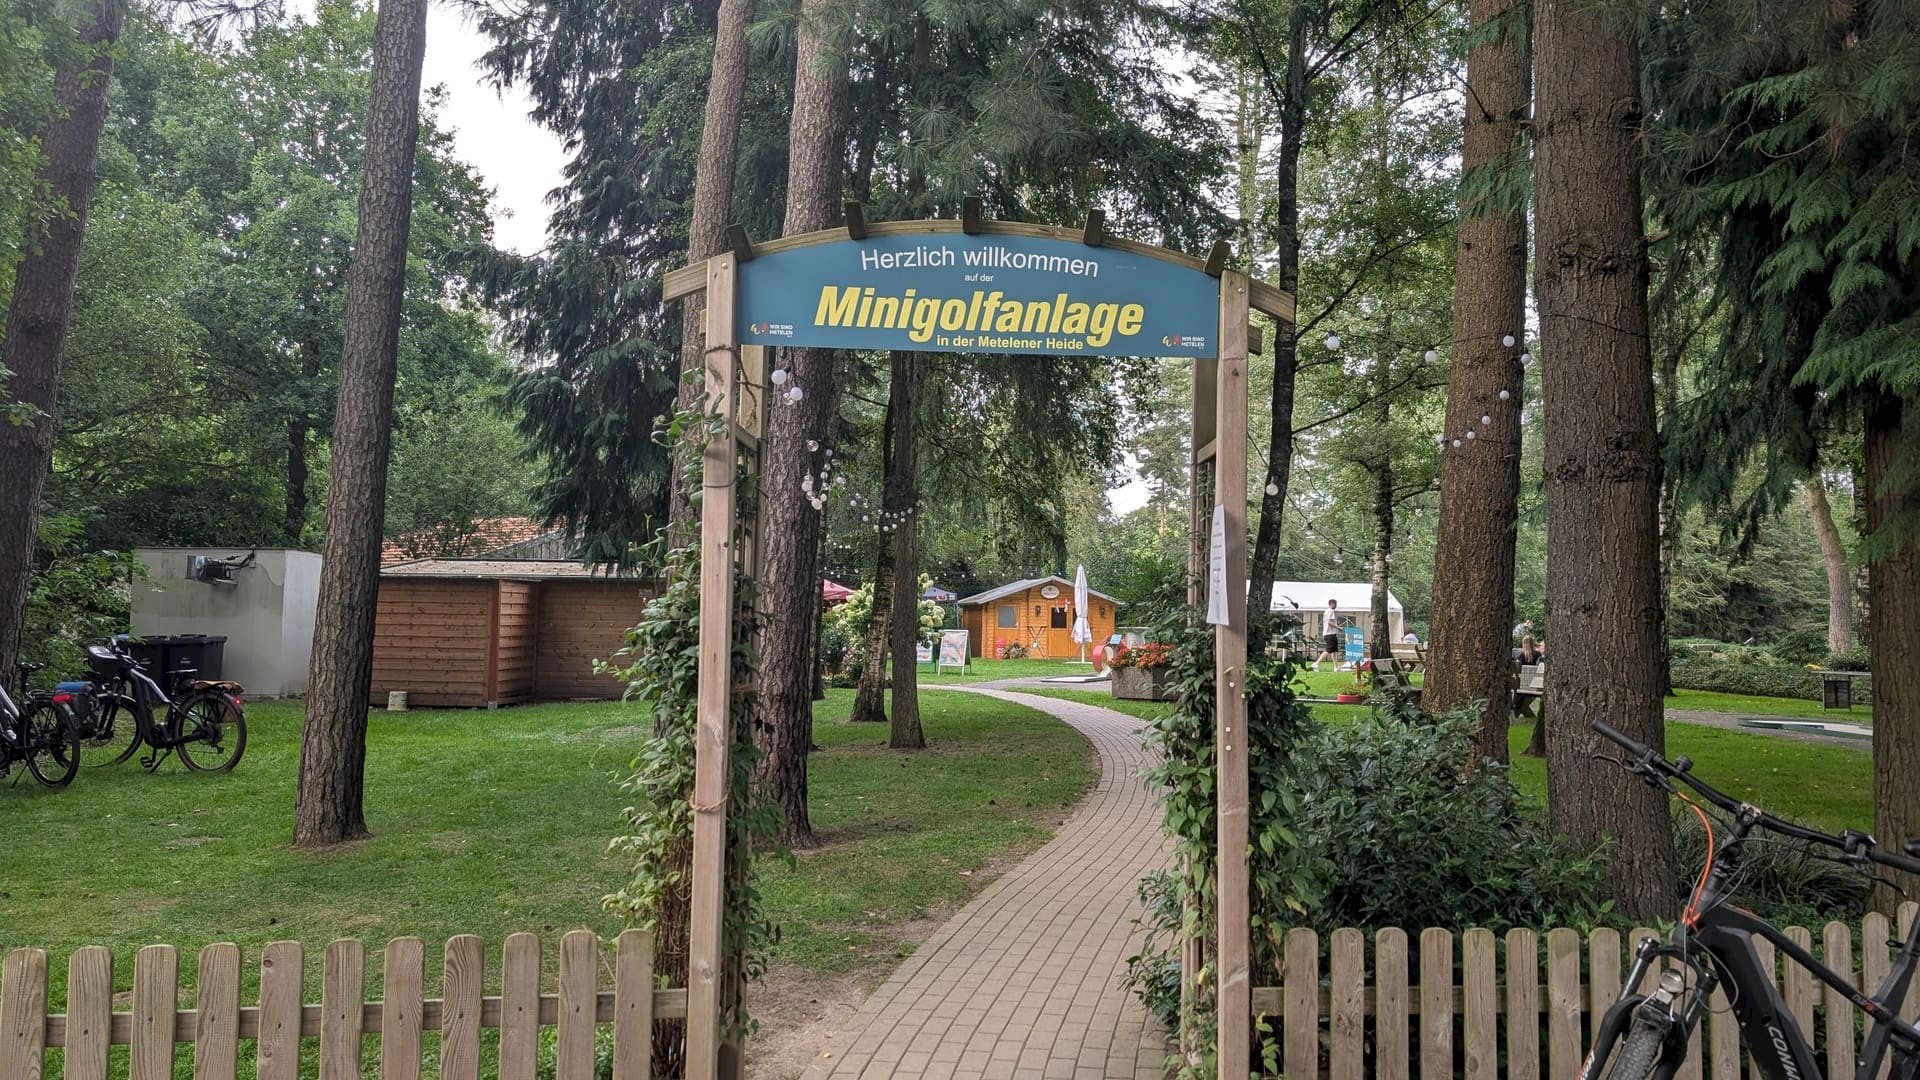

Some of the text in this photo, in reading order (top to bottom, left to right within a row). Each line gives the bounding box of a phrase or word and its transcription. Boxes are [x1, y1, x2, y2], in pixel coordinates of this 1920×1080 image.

[860, 245, 1100, 278] Herzlich willkommen
[964, 273, 994, 282] auf der
[813, 285, 1145, 347] Minigolfanlage
[936, 335, 1084, 350] in der Metelener Heide
